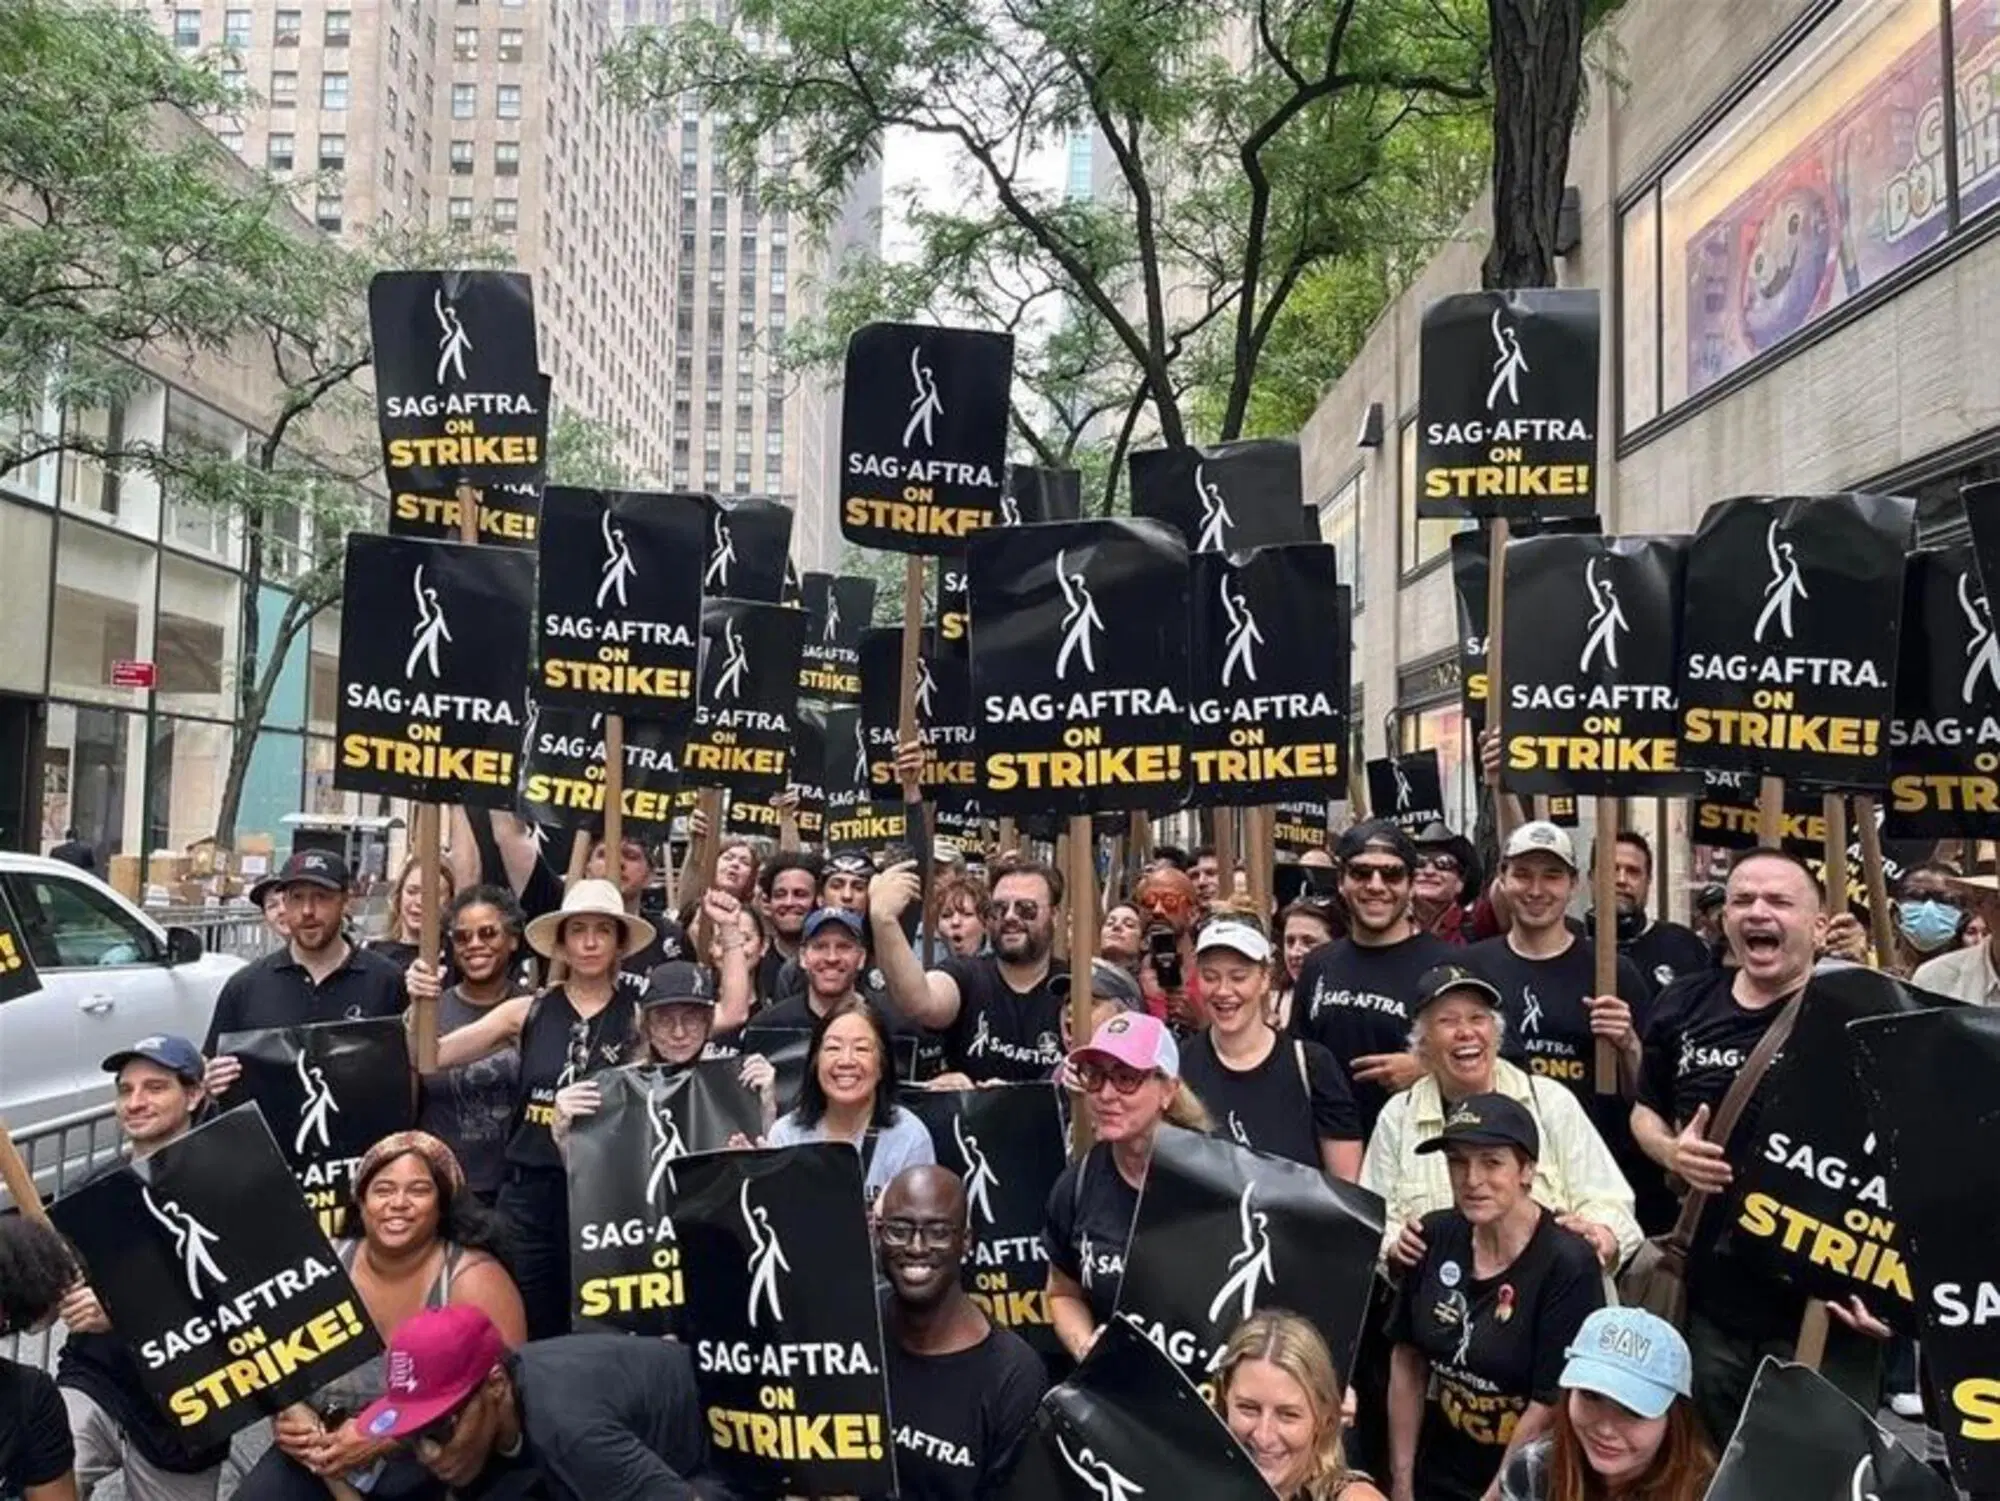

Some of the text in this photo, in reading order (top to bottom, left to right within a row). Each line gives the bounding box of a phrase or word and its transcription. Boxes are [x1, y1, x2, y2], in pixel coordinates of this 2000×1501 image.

[445, 419, 474, 434] ON
[388, 435, 538, 467] STRIKE!
[1489, 447, 1522, 462] ON
[1424, 465, 1589, 497] STRIKE!
[903, 486, 933, 504] ON
[396, 493, 537, 540] STRKE!
[598, 646, 629, 662] ON
[544, 658, 691, 698] STRIKE!
[1511, 684, 1679, 711] SAG·AFTR
[1753, 690, 1794, 710] ON
[407, 723, 442, 742] ON
[712, 731, 737, 744] ON
[1063, 727, 1102, 748] ON
[1229, 728, 1264, 747] ON
[1583, 717, 1622, 735] ON
[1684, 707, 1880, 756] STRIKE!
[342, 734, 514, 785] STRIKE!
[1508, 736, 1677, 772] STRIKE
[1974, 752, 2000, 772] O
[986, 745, 1182, 790] STRIKE!
[1844, 1208, 1895, 1242] ON
[976, 1272, 1008, 1290] ON
[227, 1326, 267, 1356] ON
[169, 1300, 364, 1427] STRIKE!
[759, 1385, 795, 1409] ON
[708, 1406, 883, 1460] STRIKE!
